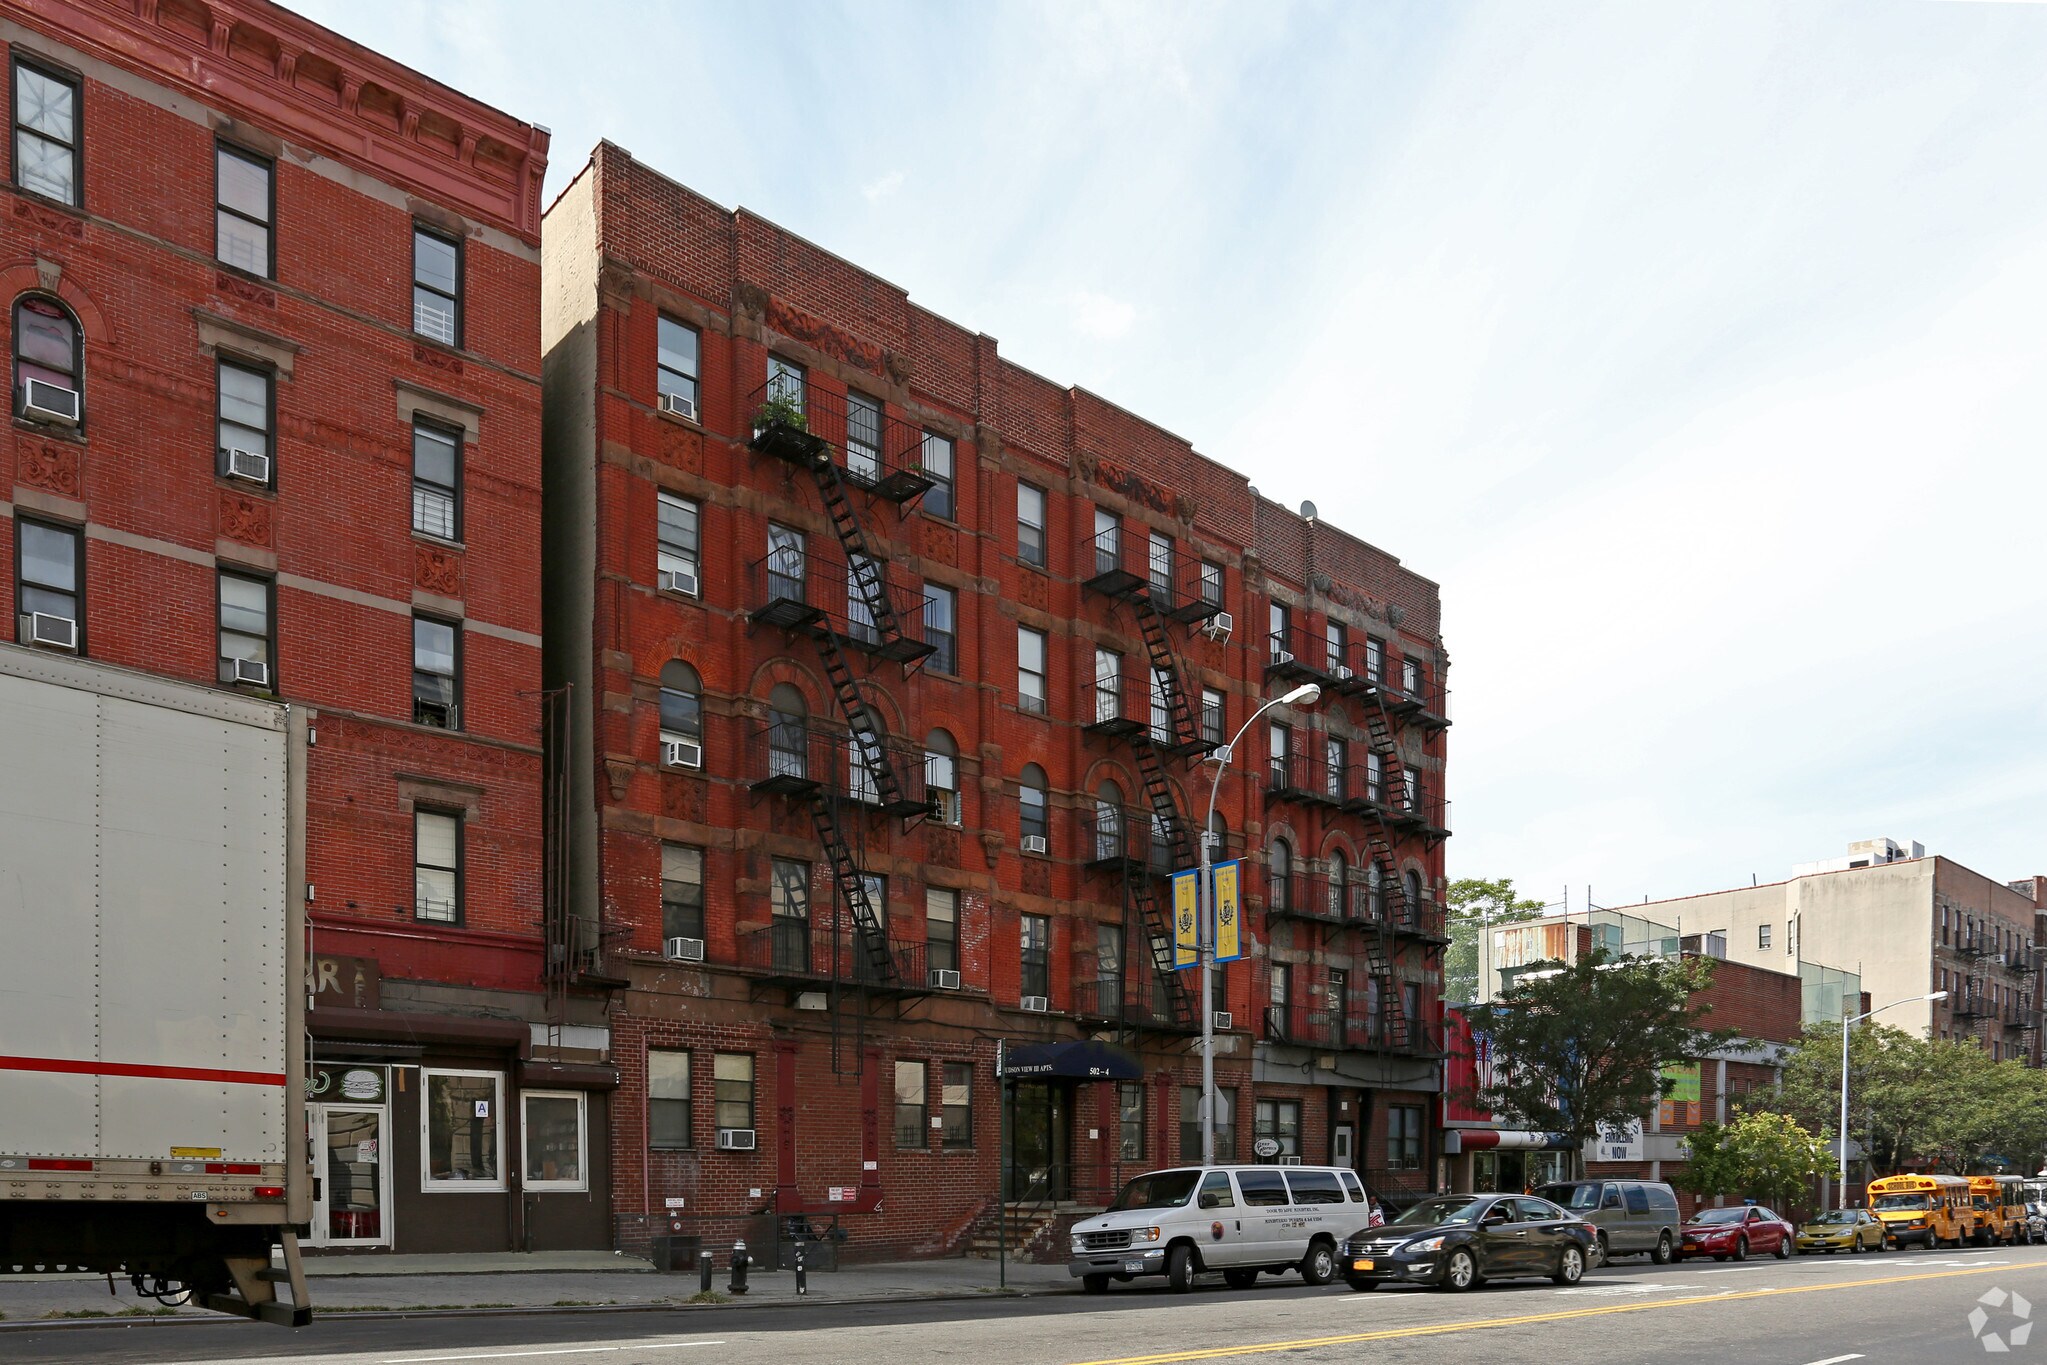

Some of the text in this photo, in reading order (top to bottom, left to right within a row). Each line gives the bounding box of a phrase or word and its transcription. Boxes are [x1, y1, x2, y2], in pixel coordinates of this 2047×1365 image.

[1003, 1066, 1020, 1074] UDSON
[1021, 1065, 1033, 1073] VIEW
[1040, 1063, 1053, 1072] APTS.
[477, 1102, 487, 1113] A
[1612, 1146, 1627, 1159] NOW
